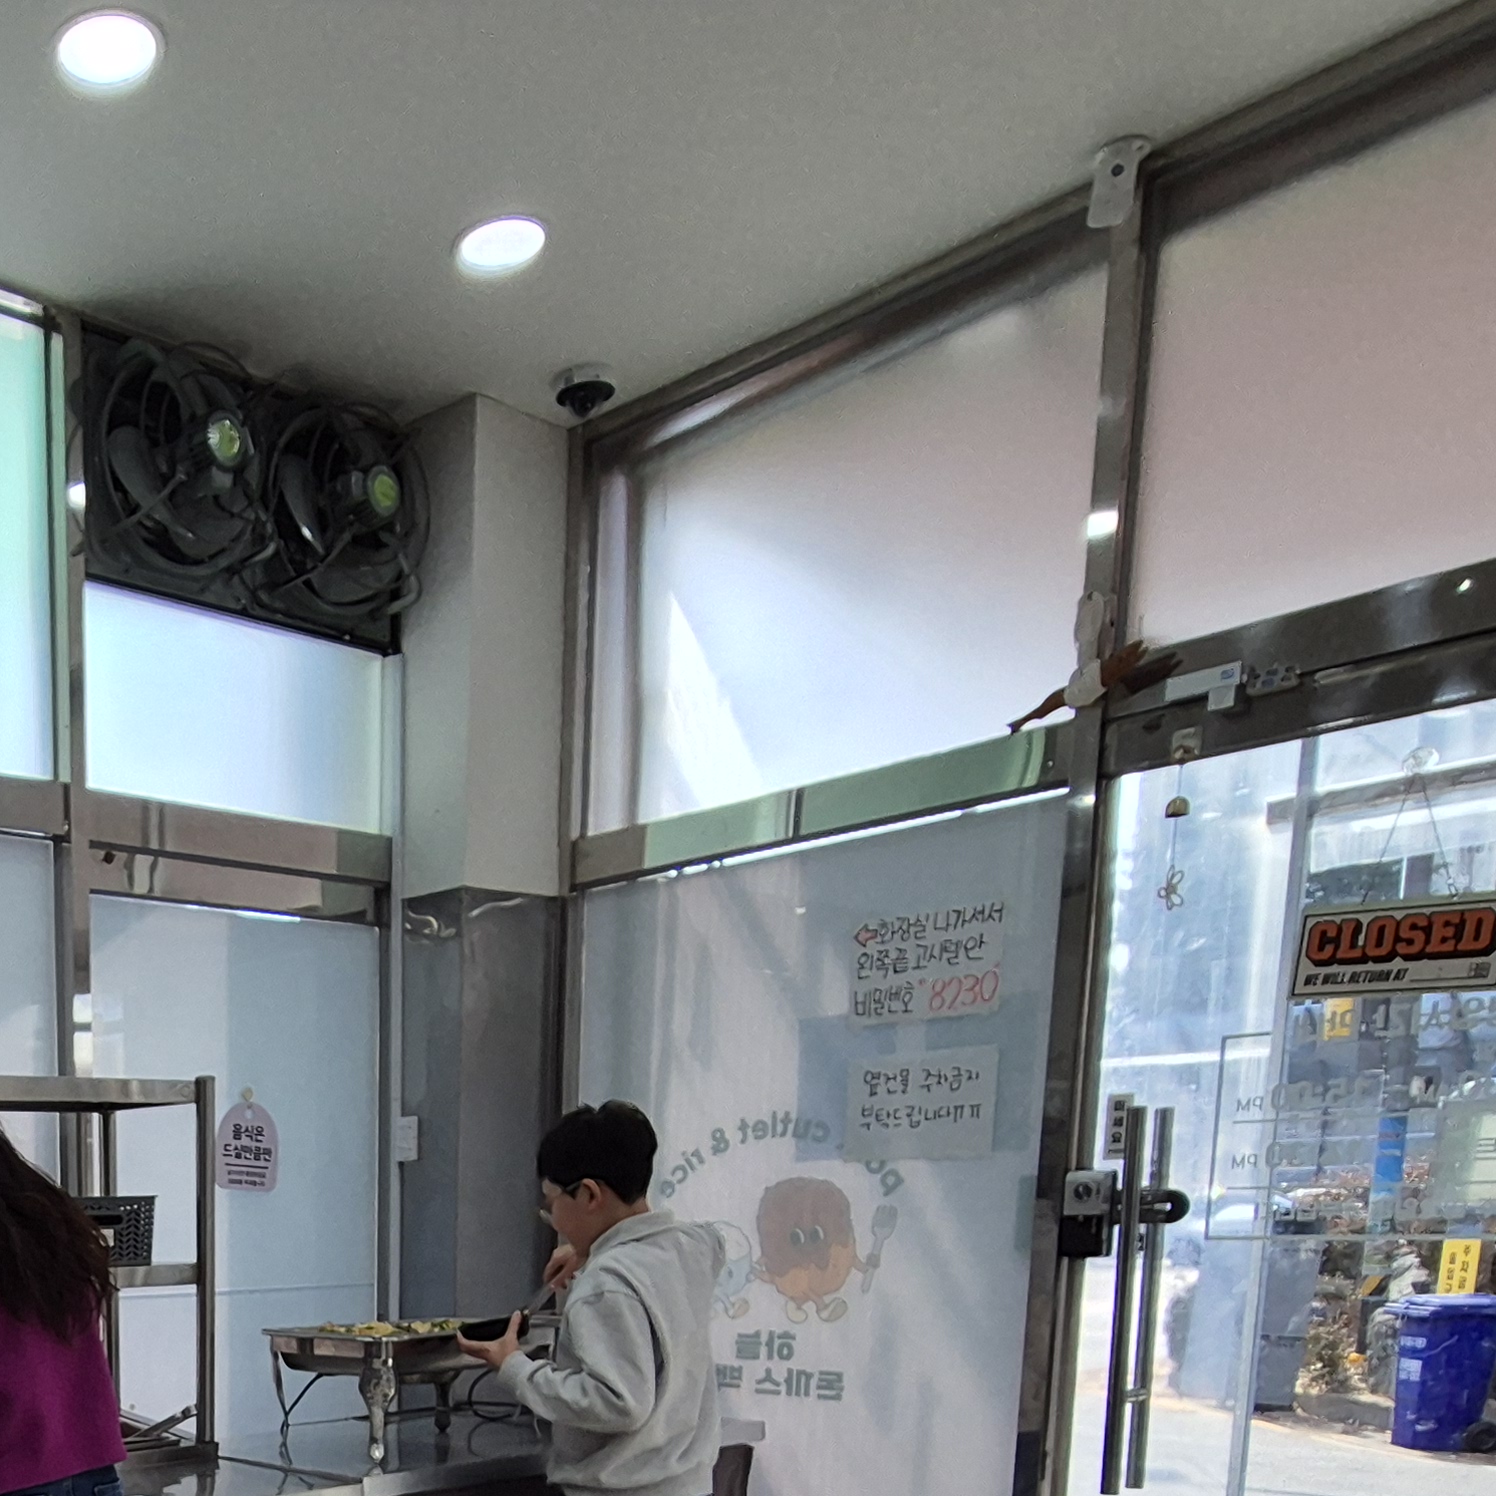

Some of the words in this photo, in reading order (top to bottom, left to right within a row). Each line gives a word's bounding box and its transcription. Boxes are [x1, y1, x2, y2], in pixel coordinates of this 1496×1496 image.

[875, 913, 929, 944] 화장실
[1305, 907, 1496, 967] CLOSED
[1304, 973, 1321, 987] WE
[1321, 971, 1347, 985] WILL
[1347, 968, 1394, 984] RETURN
[1394, 967, 1409, 982] AT
[854, 981, 914, 1018] 비밀번호
[919, 1066, 980, 1093] 주차금지
[232, 1123, 265, 1143] 음식은
